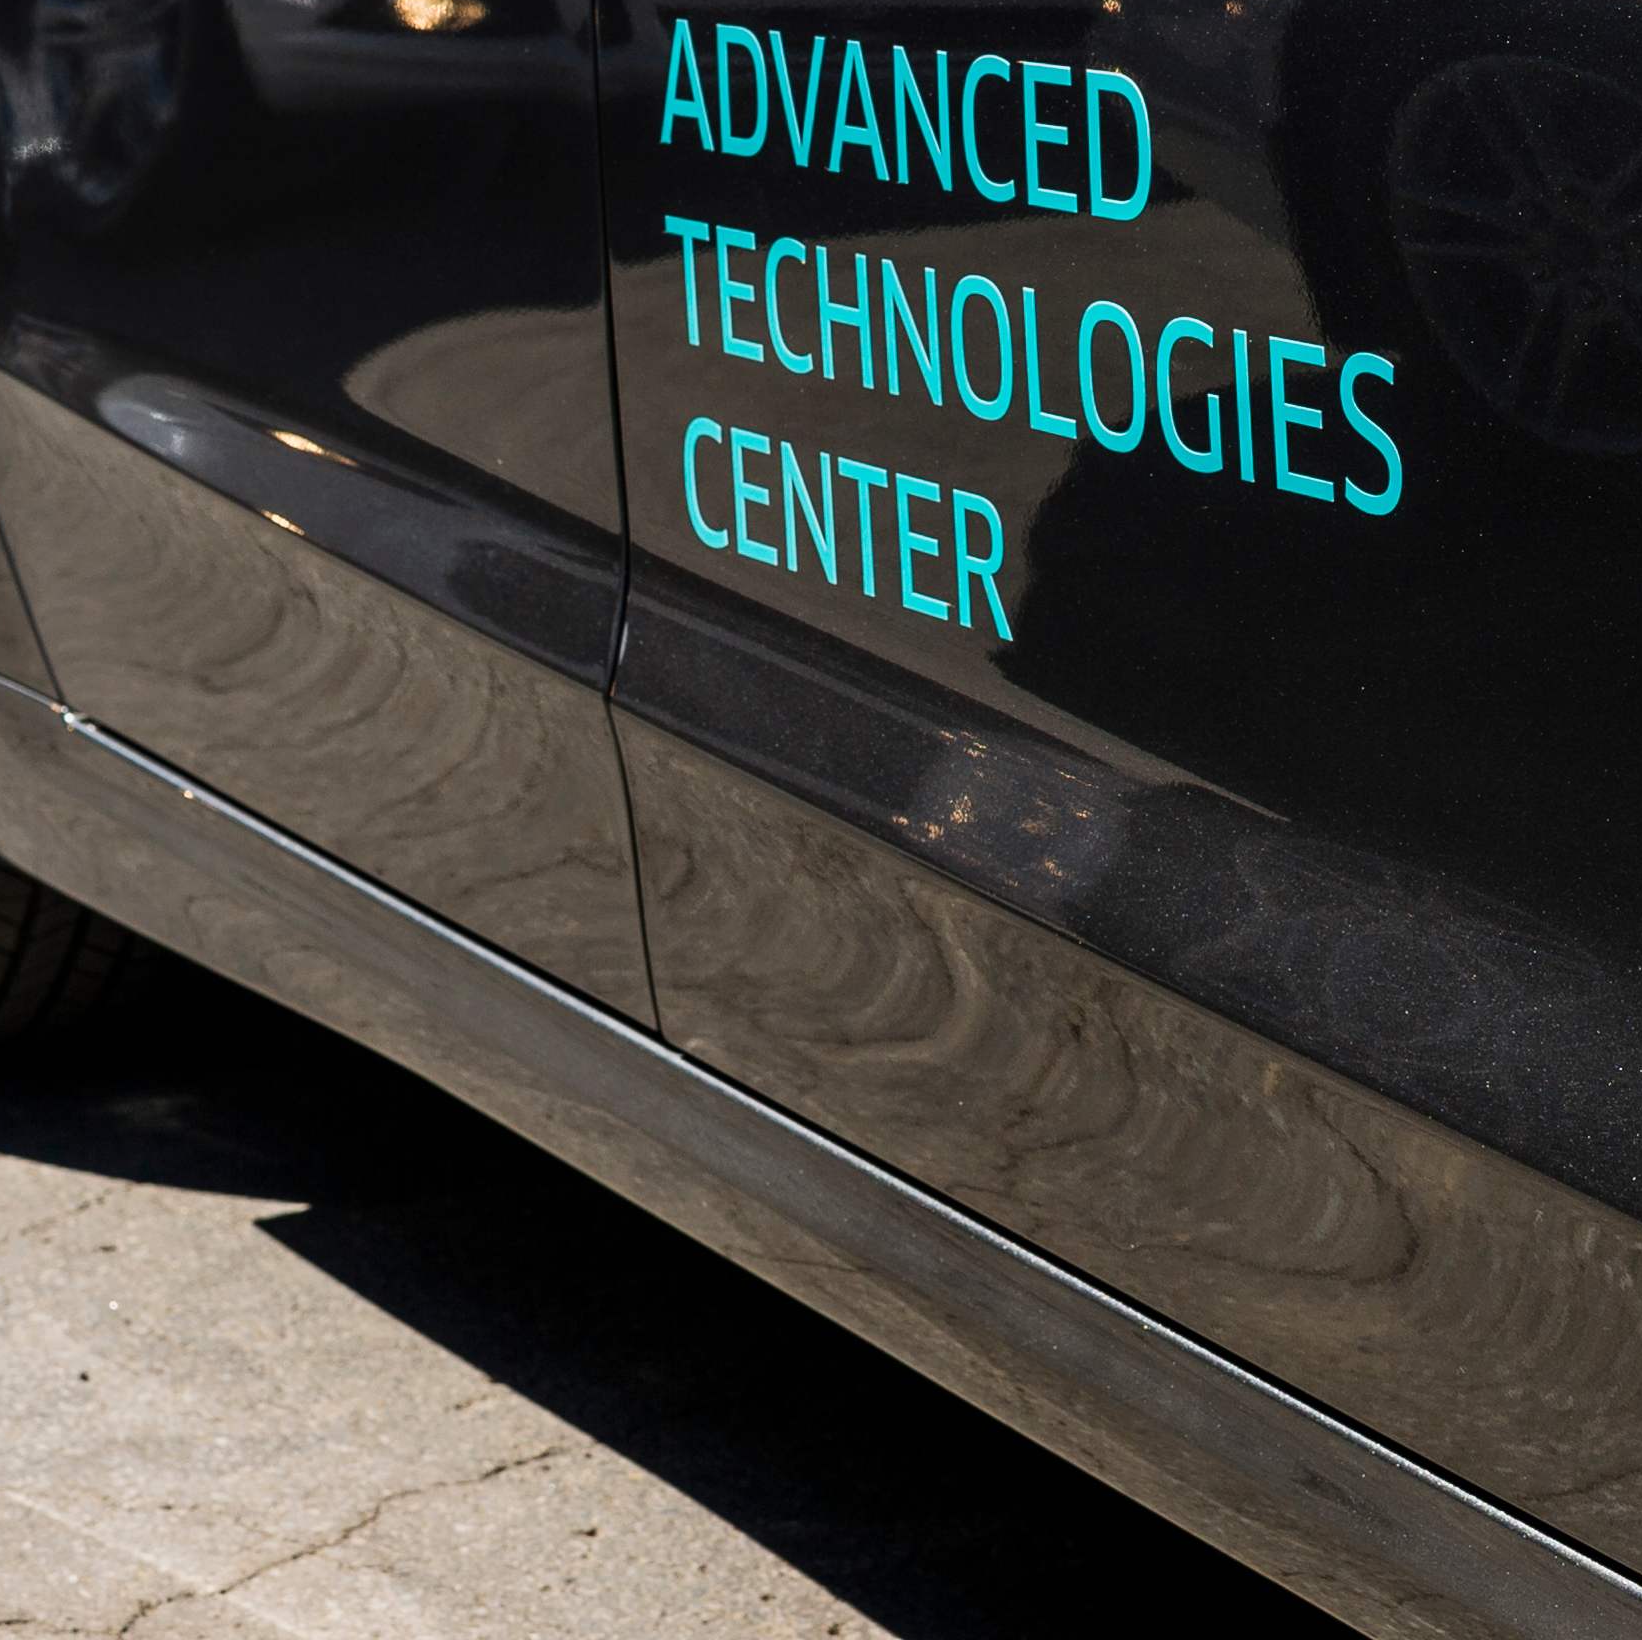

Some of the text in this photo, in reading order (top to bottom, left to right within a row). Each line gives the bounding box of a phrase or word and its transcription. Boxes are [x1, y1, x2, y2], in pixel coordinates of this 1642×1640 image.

[660, 18, 1152, 221] ADVANCED
[664, 215, 1403, 516] TECHNOLOGIES
[684, 417, 1012, 641] CENTER
